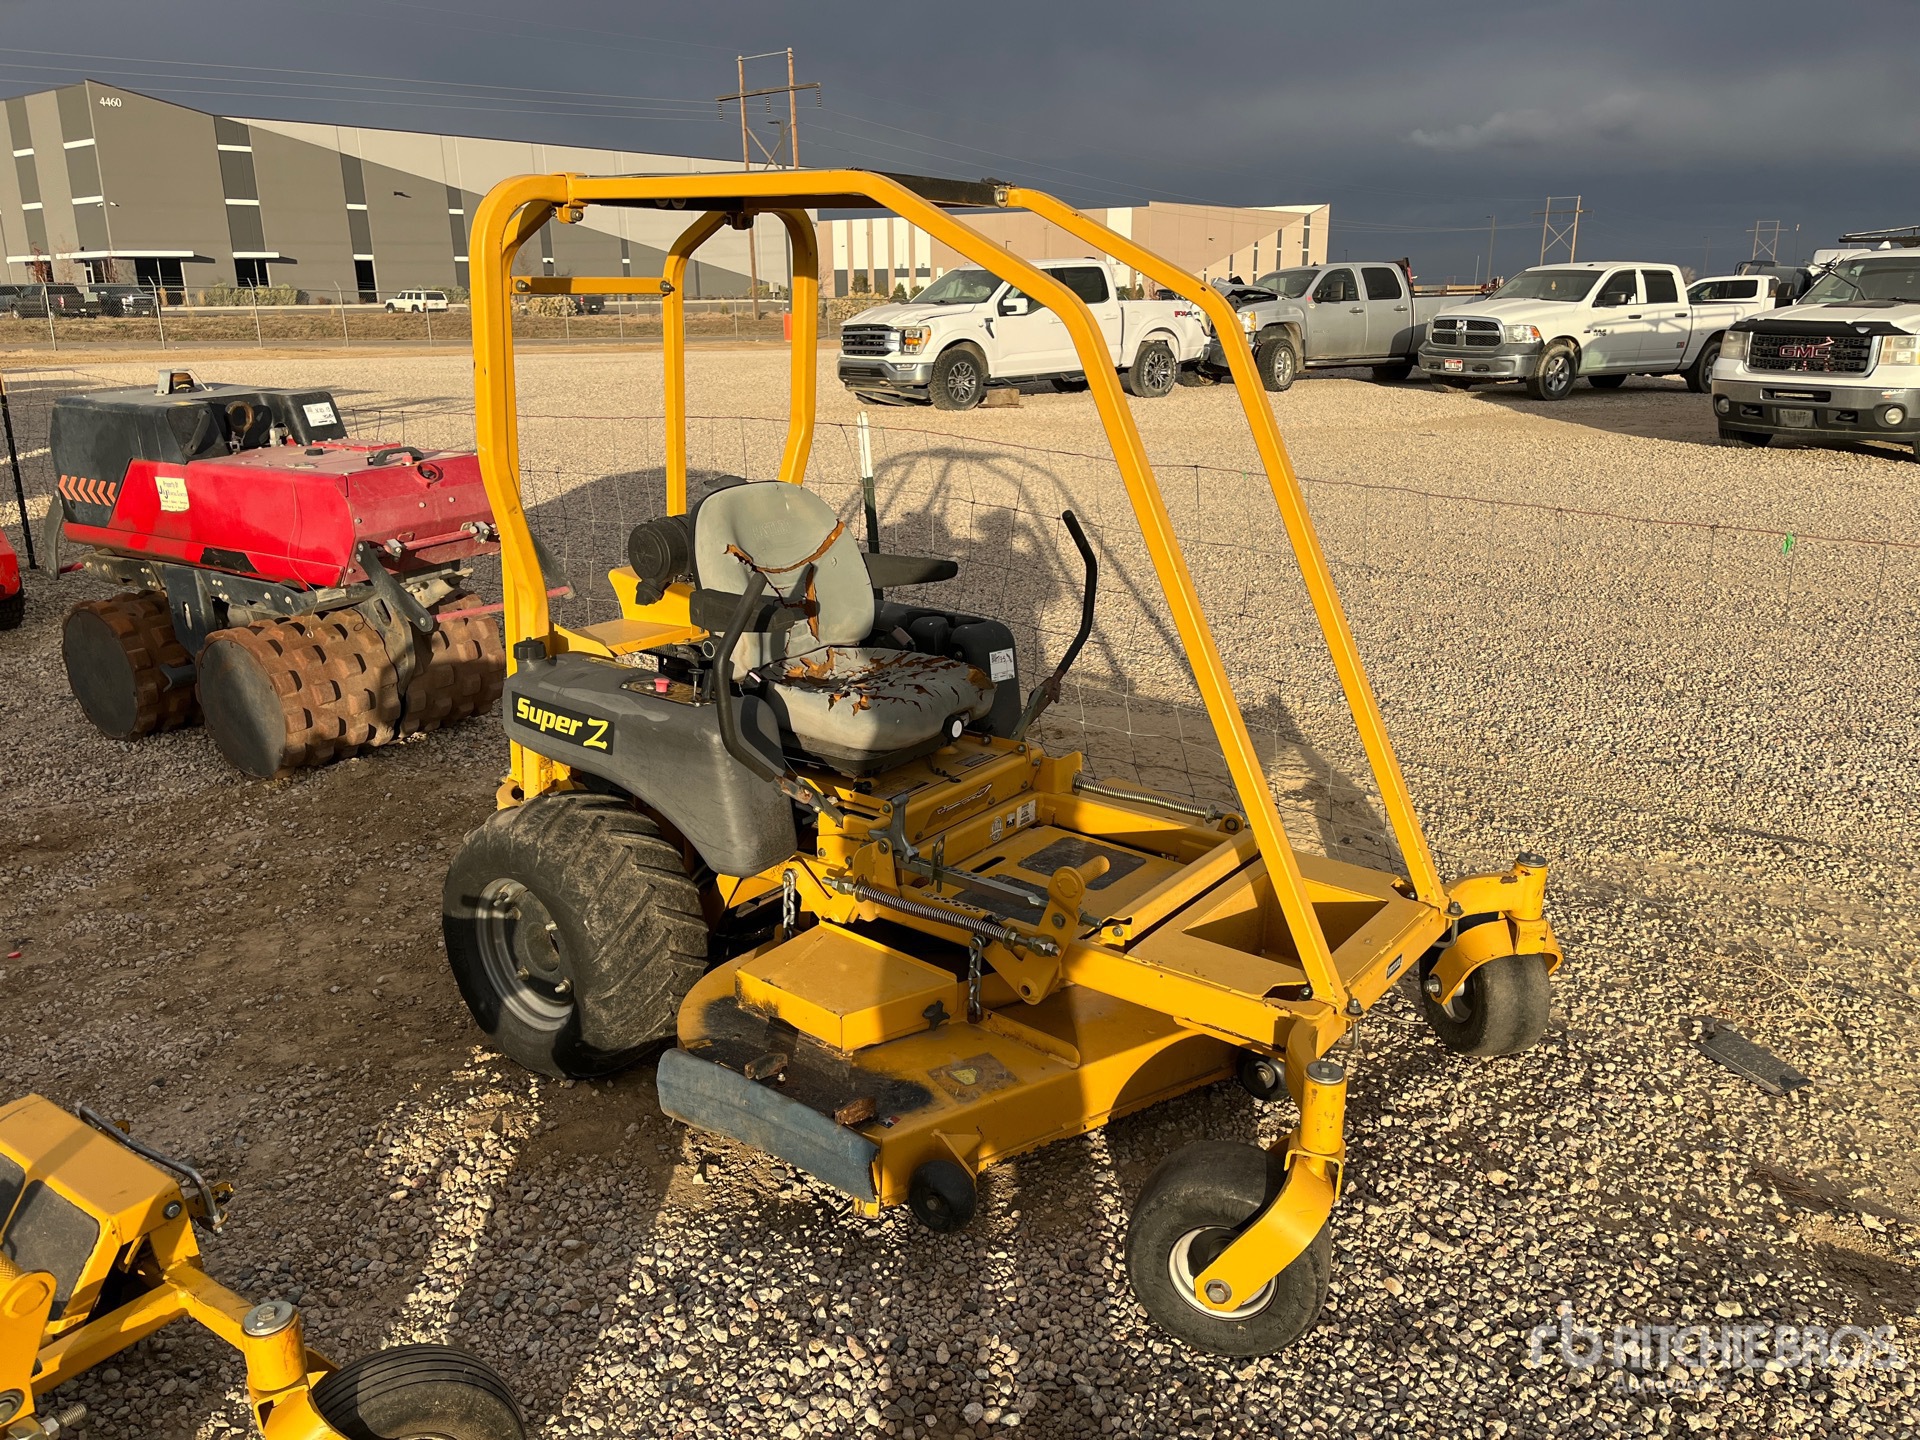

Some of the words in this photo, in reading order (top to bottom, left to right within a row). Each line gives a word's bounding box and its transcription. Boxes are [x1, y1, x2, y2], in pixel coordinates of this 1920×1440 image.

[99, 96, 122, 108] 4460
[1780, 344, 1831, 358] GMC
[516, 697, 583, 736] Super
[583, 717, 609, 750] Z
